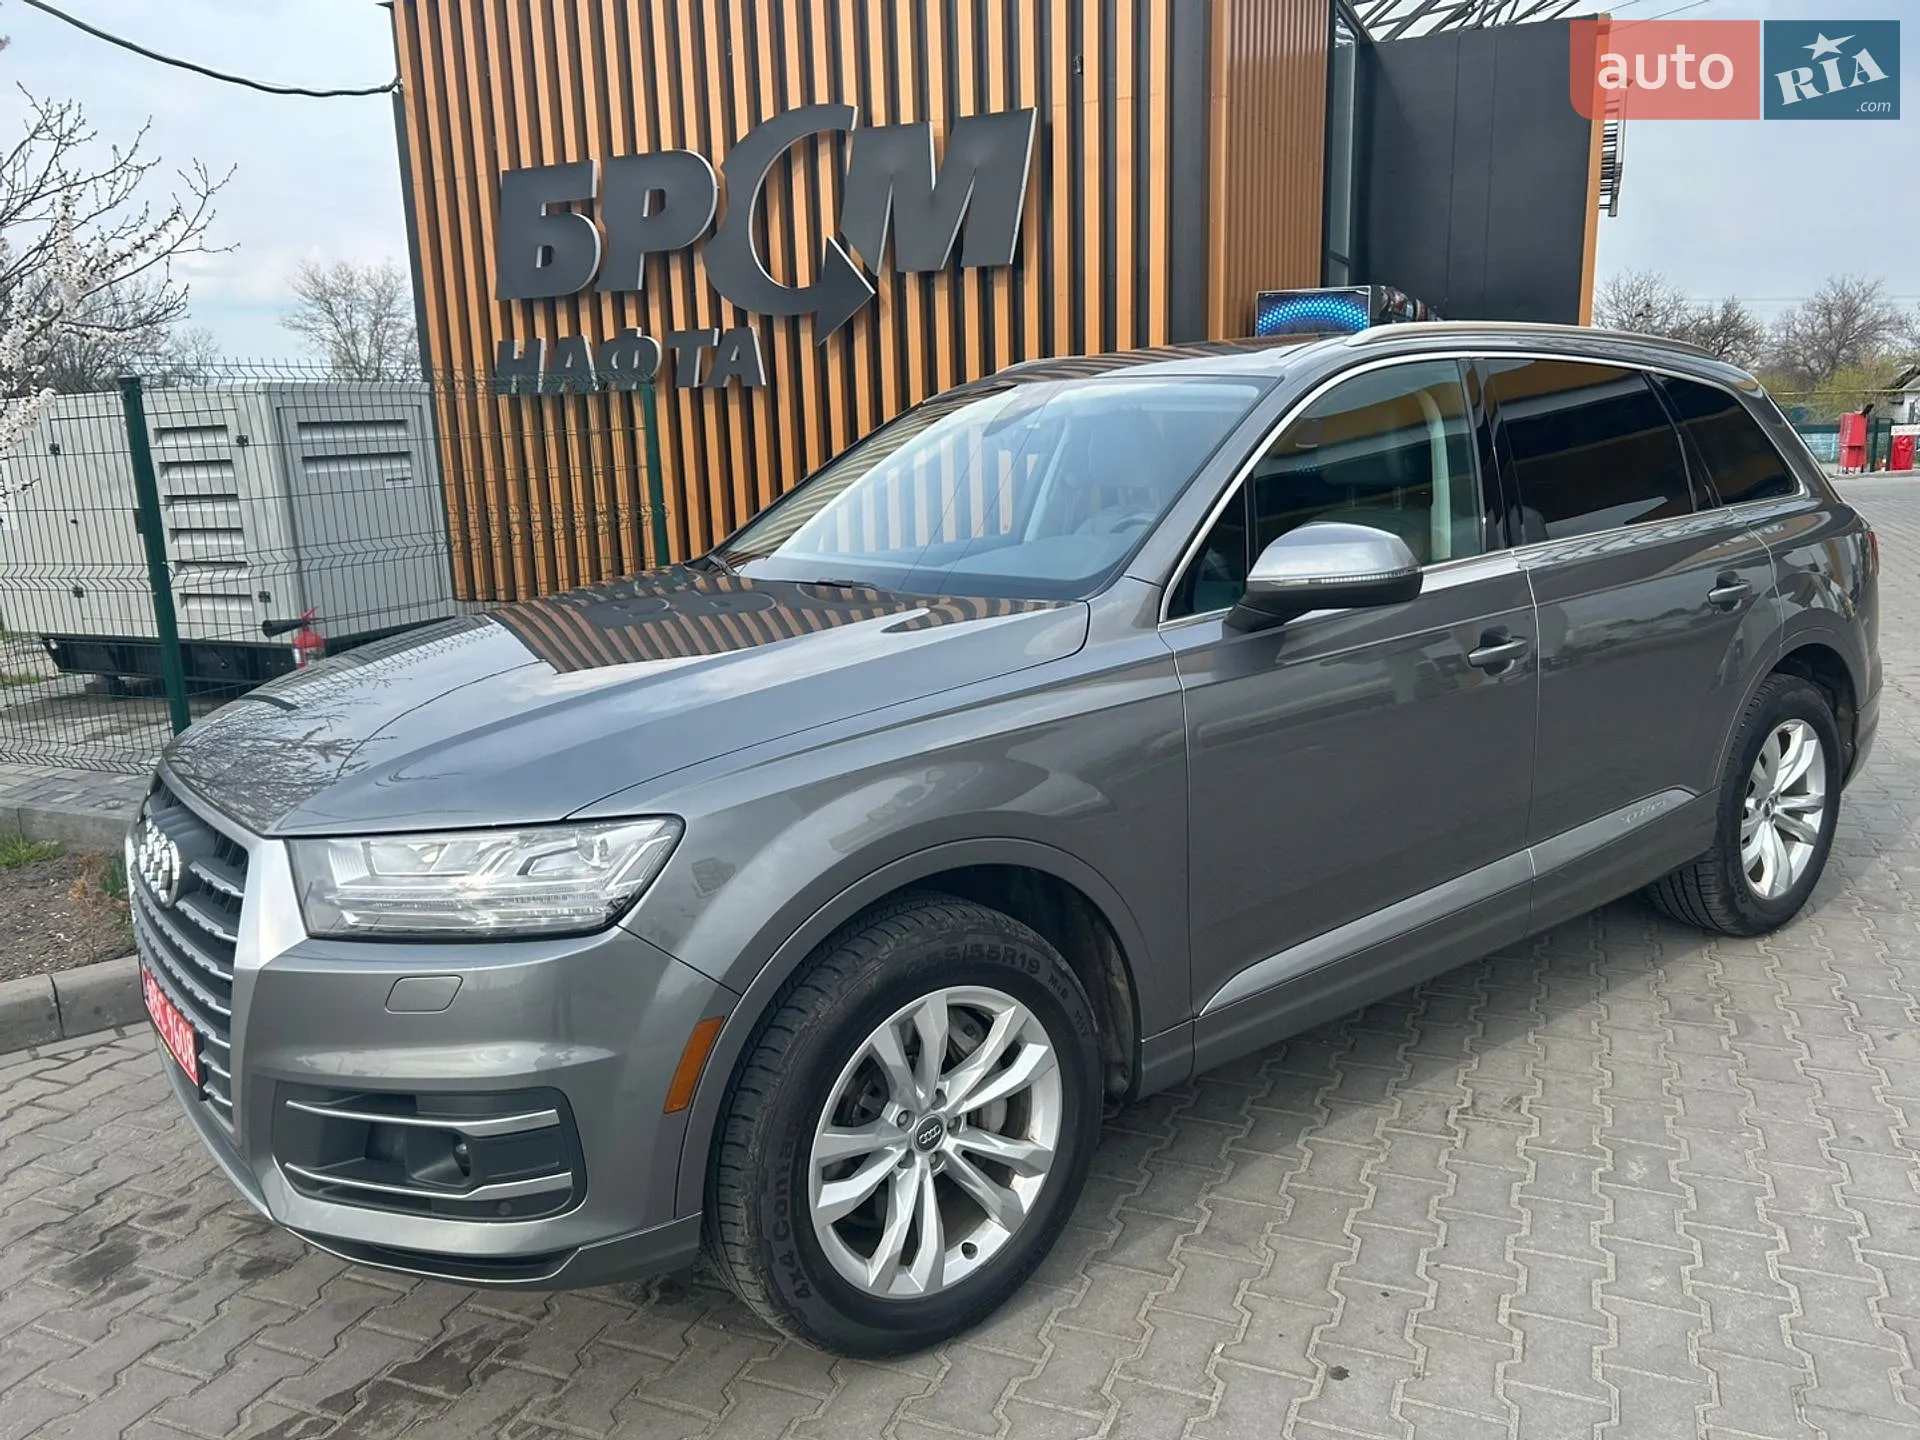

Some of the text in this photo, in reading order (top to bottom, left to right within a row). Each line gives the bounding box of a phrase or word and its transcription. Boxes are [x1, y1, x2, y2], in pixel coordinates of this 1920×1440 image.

[496, 103, 1037, 346] БРСМ
[496, 326, 767, 394] НАФТА
[772, 1111, 800, 1242] Contac
